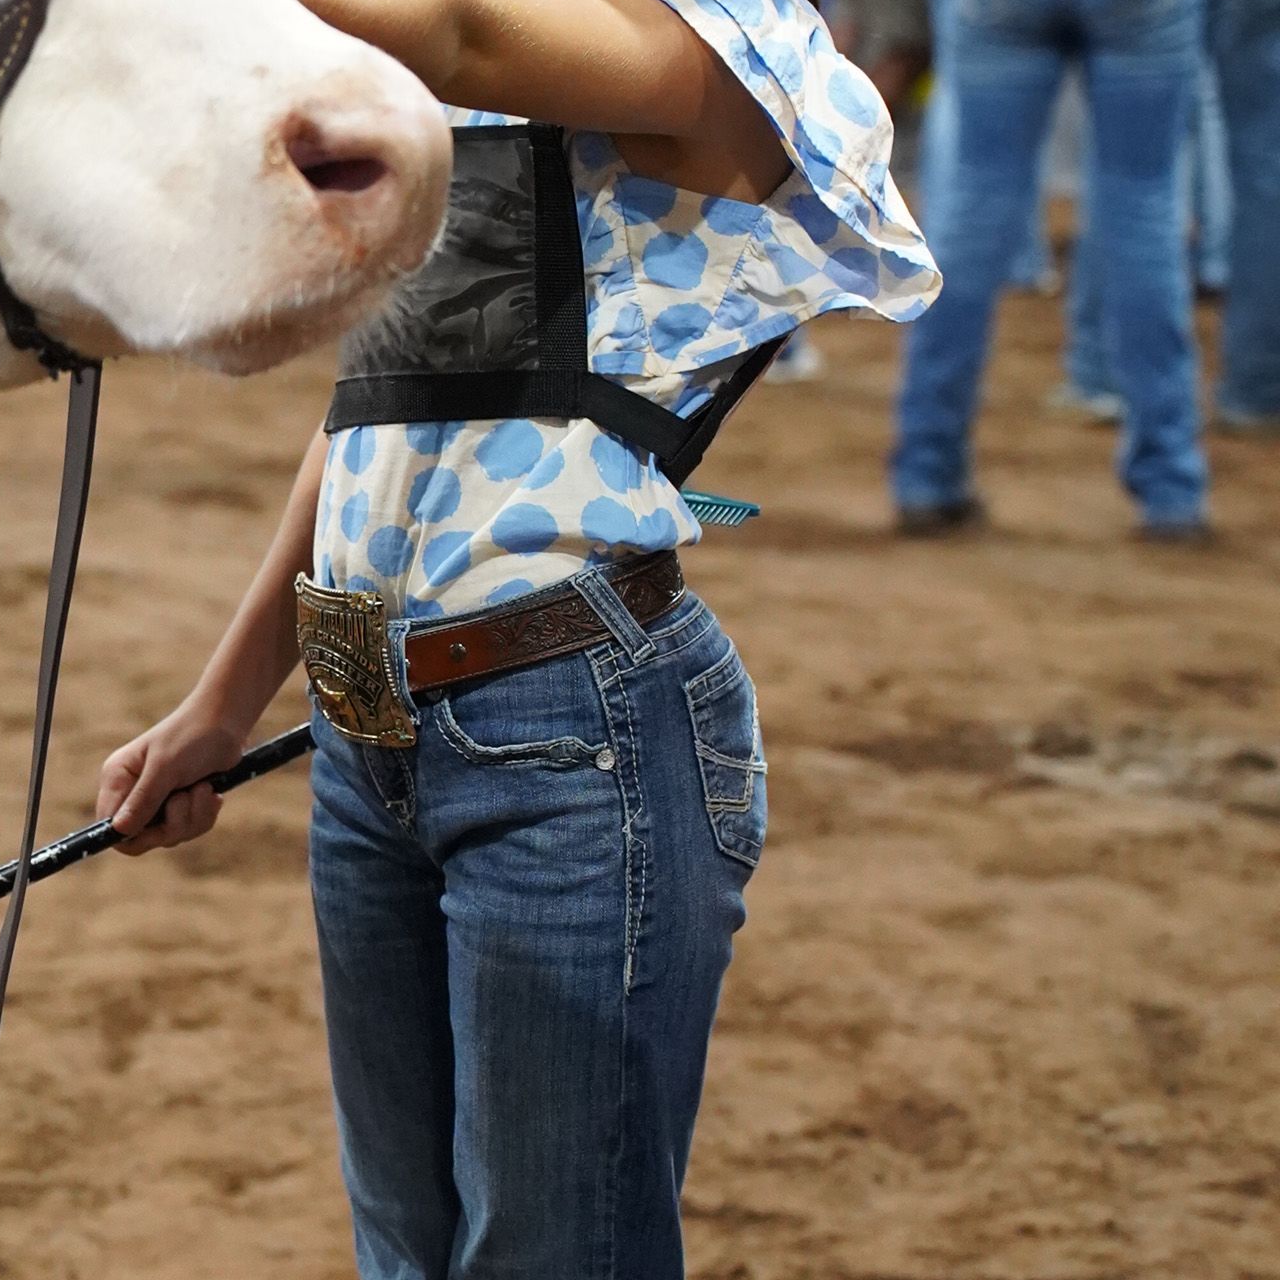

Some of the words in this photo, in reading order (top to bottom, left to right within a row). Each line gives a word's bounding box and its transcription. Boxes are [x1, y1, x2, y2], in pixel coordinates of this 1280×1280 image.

[322, 610, 345, 635] FIELD
[347, 613, 365, 649] DAY
[317, 629, 379, 673] CHAMPION
